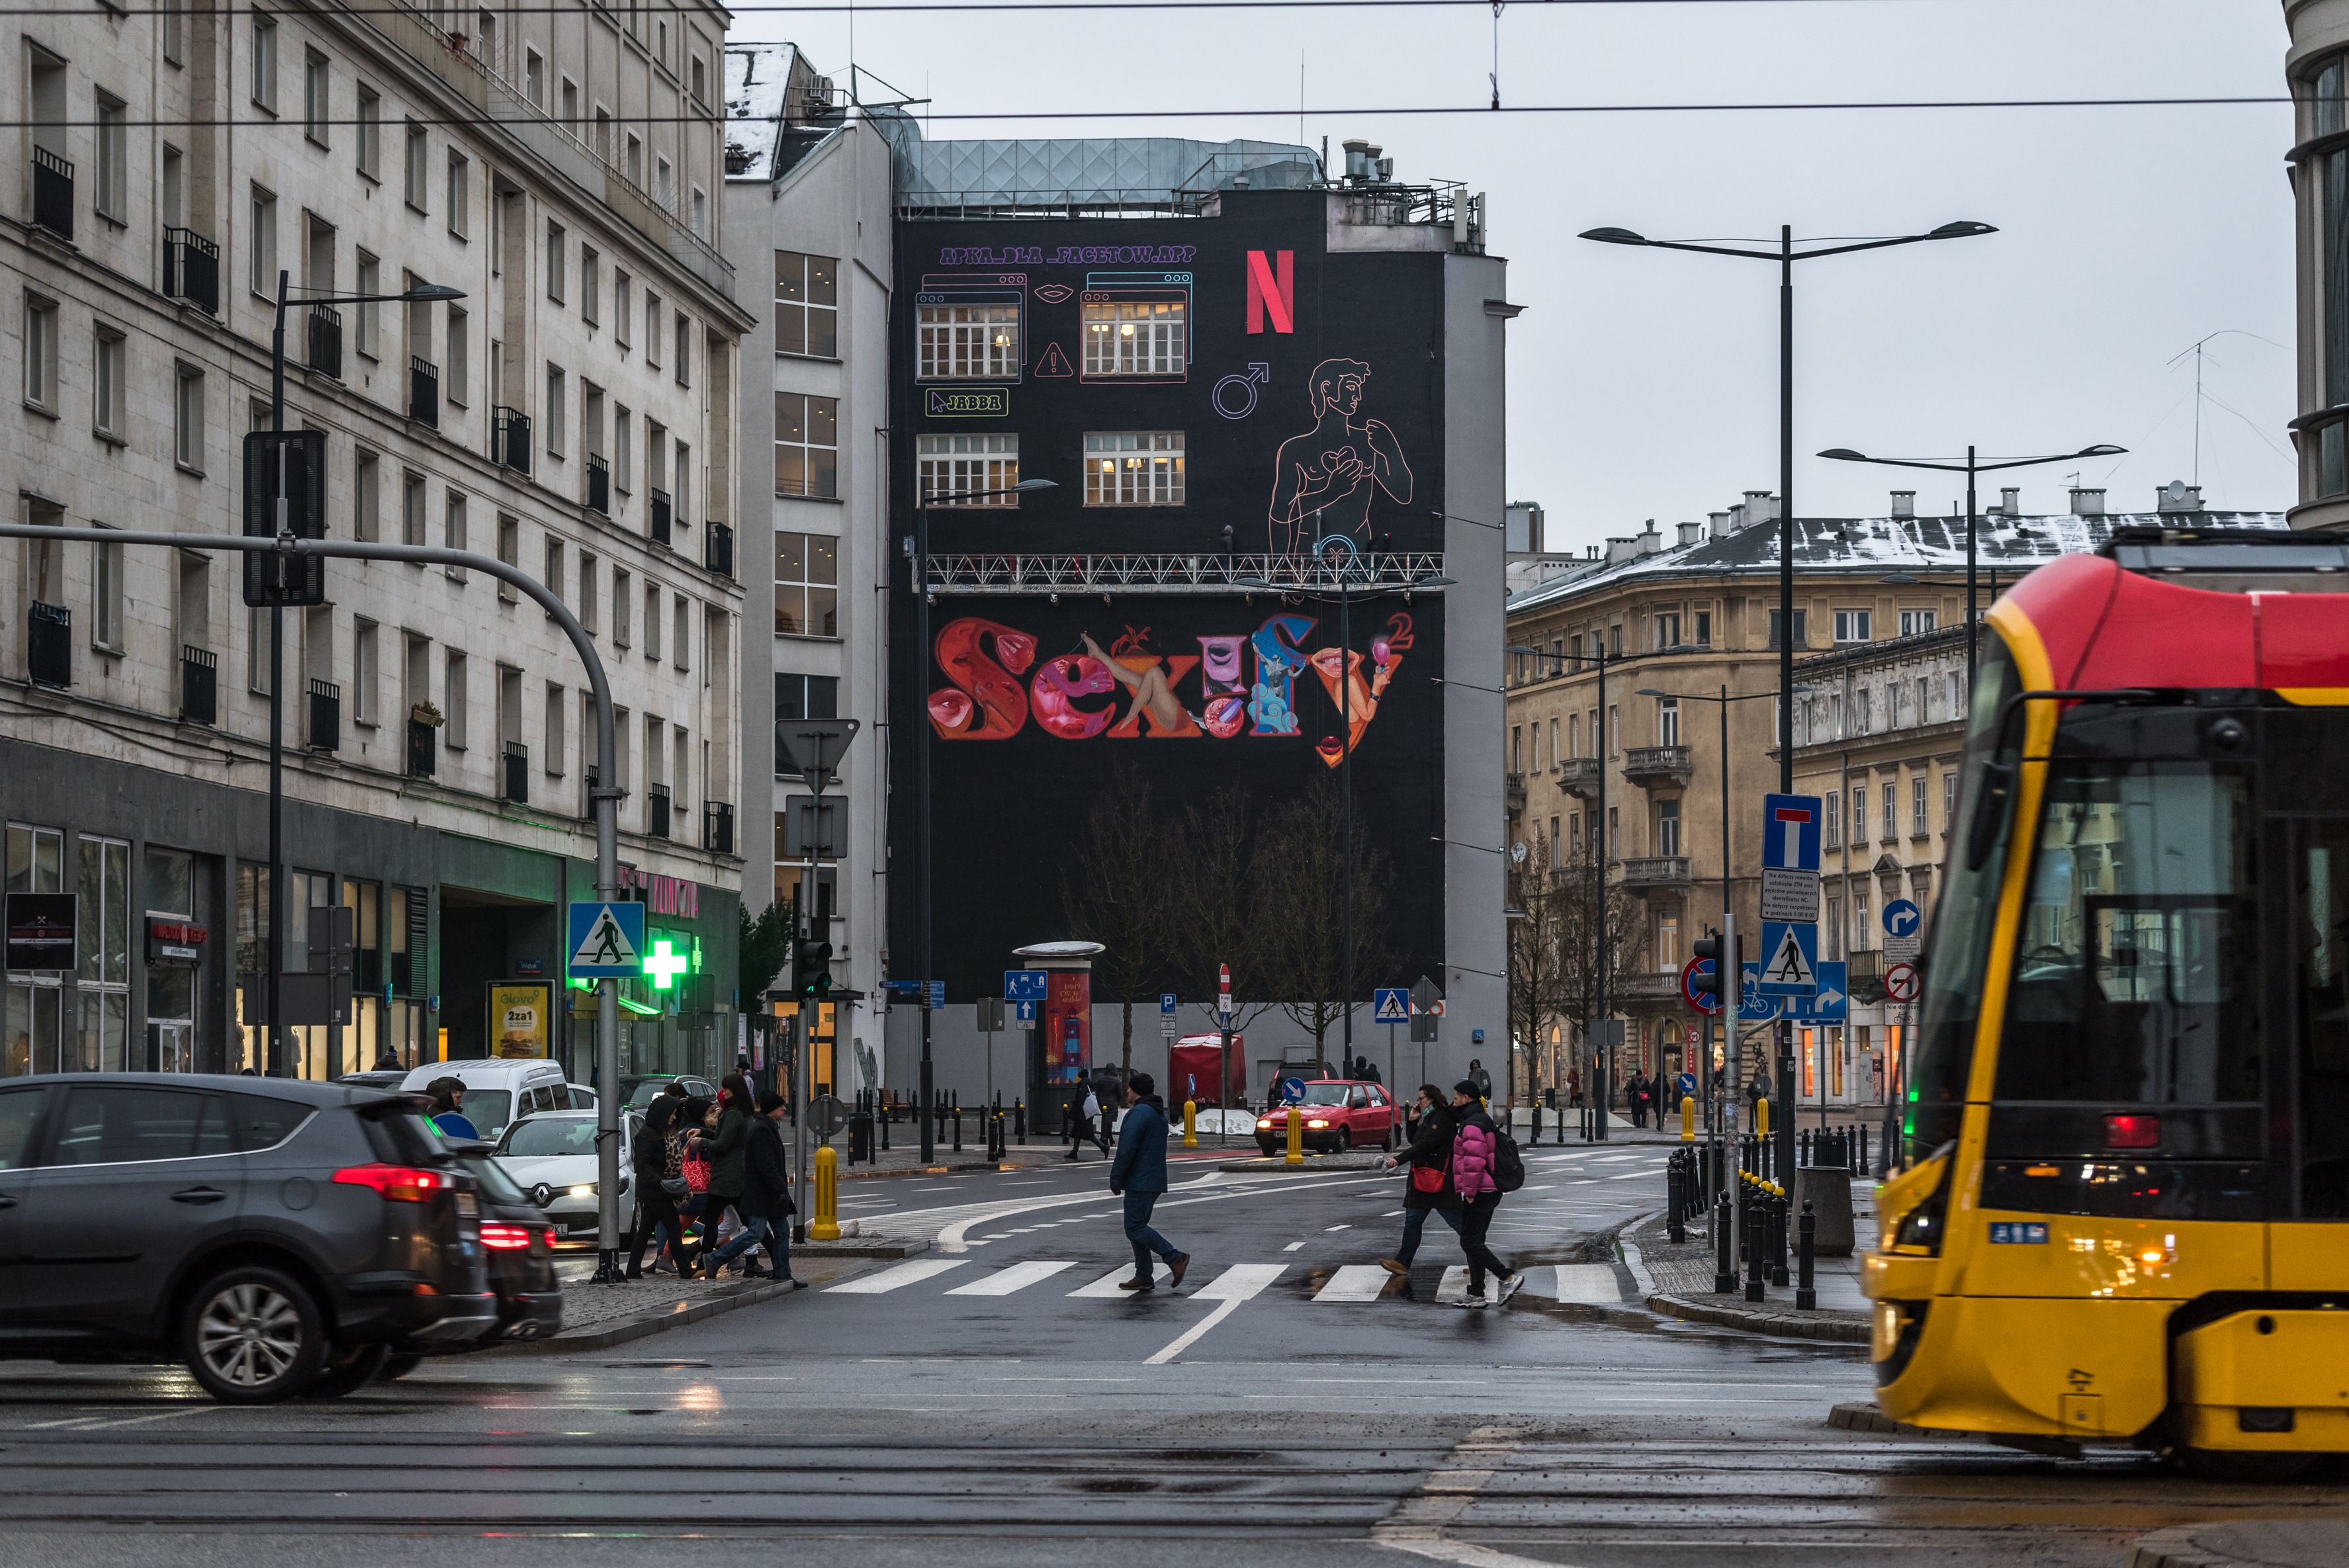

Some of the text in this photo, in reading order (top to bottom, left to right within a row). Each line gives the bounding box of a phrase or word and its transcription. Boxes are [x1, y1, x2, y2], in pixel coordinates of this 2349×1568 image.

[1247, 250, 1294, 334] N
[946, 395, 1001, 410] JABBA
[501, 993, 535, 1004] Glovo
[550, 1225, 566, 1233] 2KL
